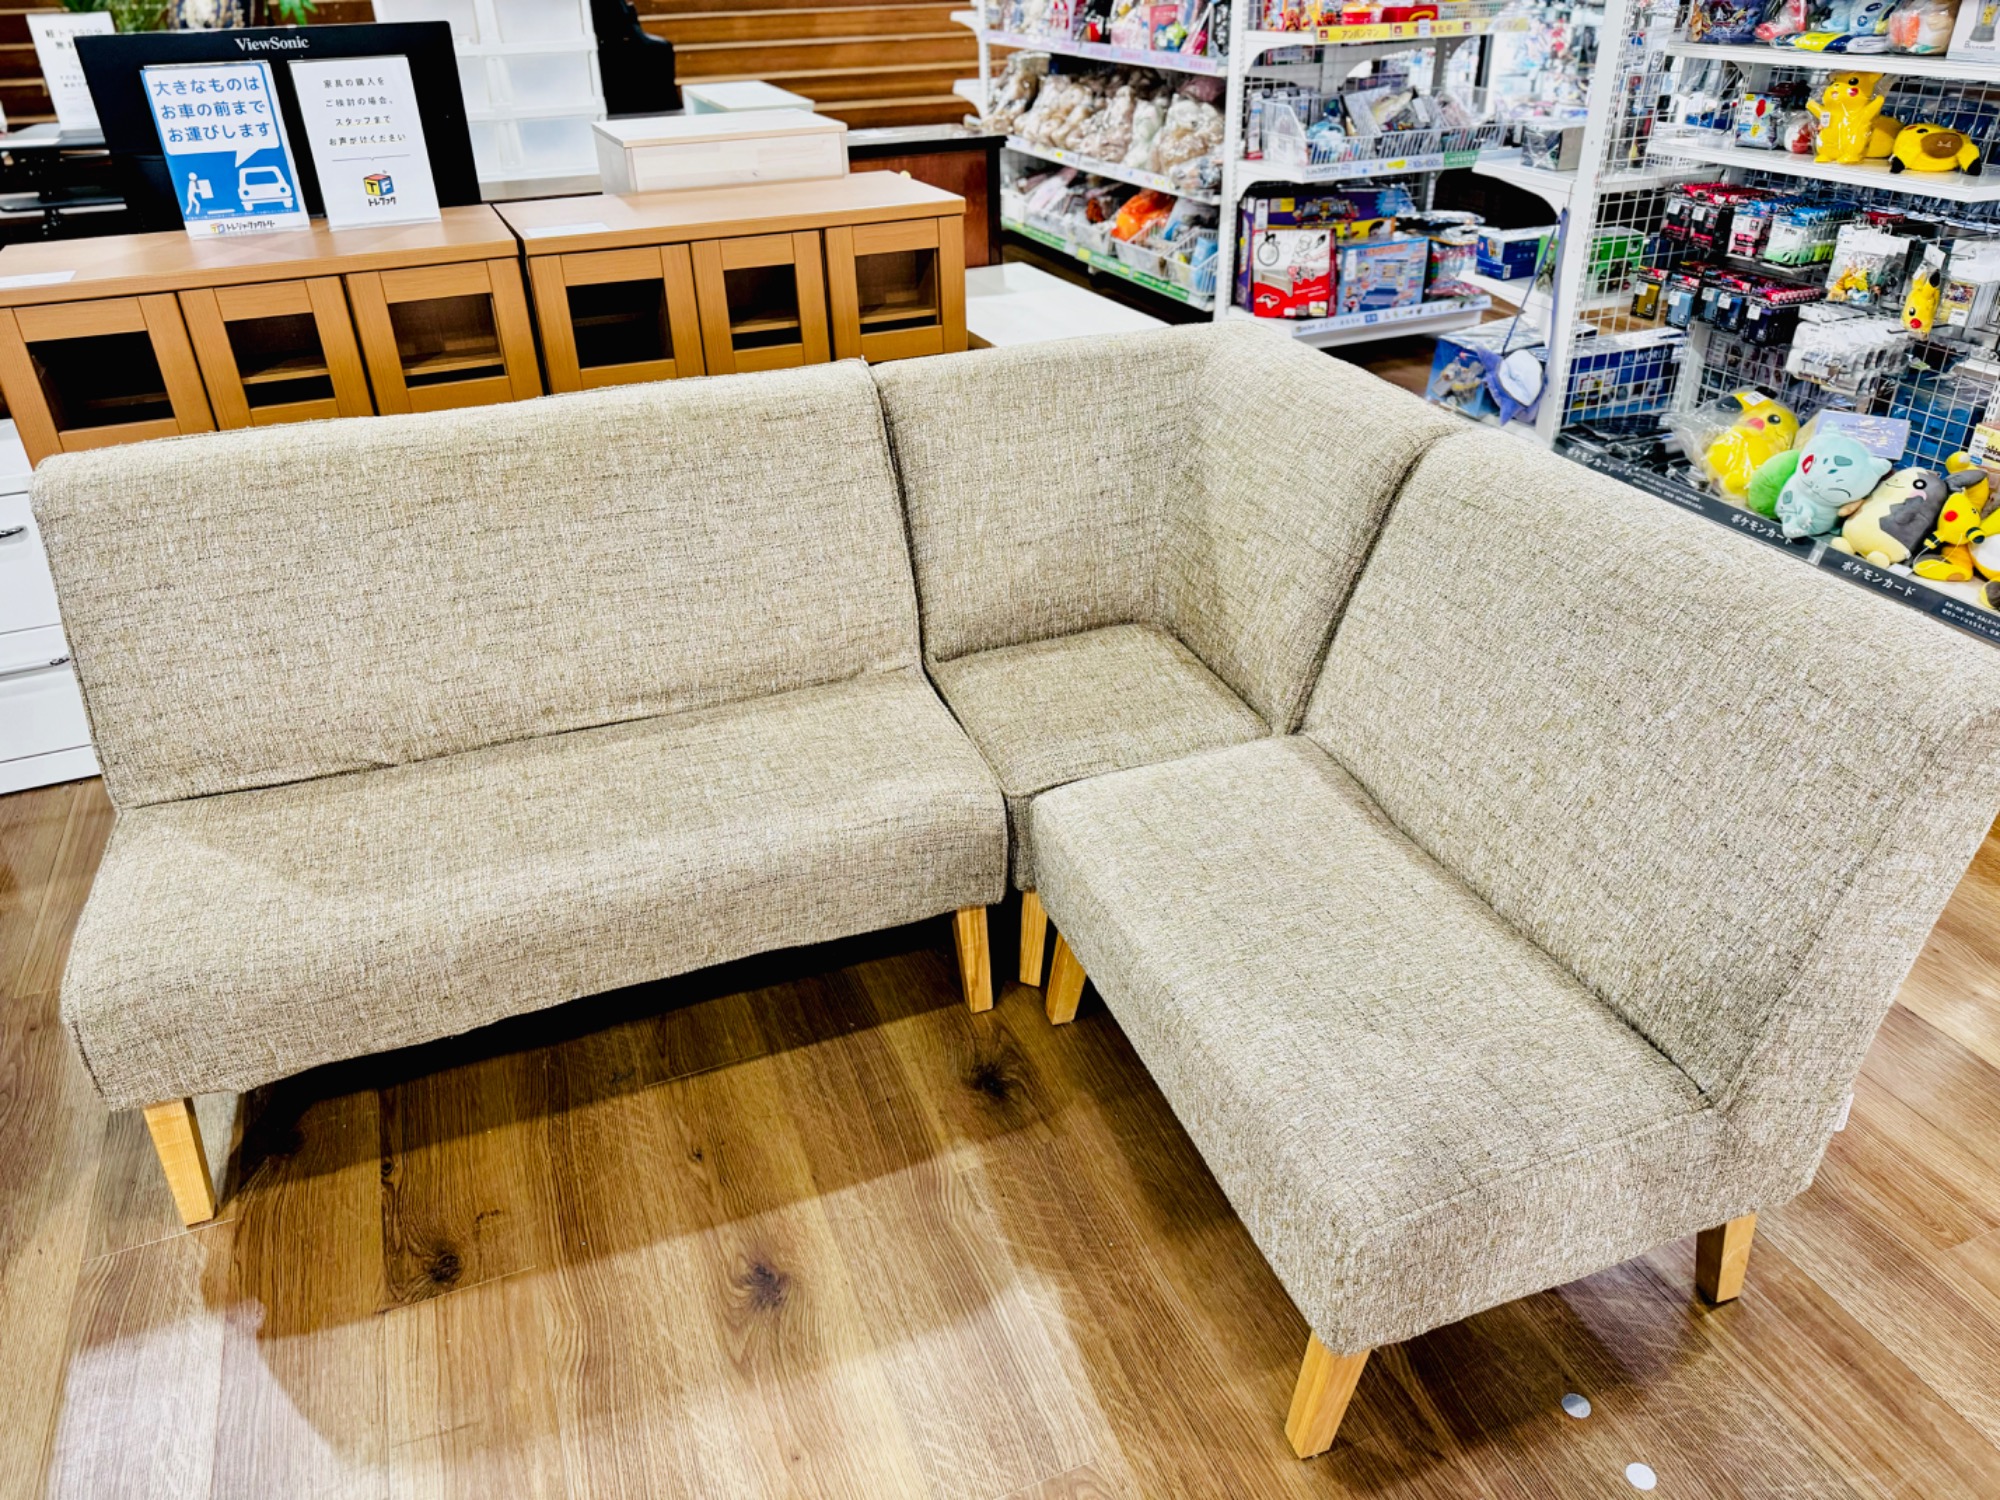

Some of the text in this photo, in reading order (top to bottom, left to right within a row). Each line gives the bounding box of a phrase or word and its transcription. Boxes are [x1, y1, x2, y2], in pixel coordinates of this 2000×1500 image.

[234, 36, 310, 51] ViewSonic
[153, 76, 261, 97] 大きなものは
[323, 77, 385, 88] 家具の購入を
[325, 96, 393, 108] ご検討の場合、
[160, 100, 266, 120] お車の前まで
[335, 115, 392, 126] スタッフまで
[167, 122, 271, 143] お運びします
[329, 134, 406, 146] お声がけください
[1841, 561, 1917, 597] ポケモンカード
